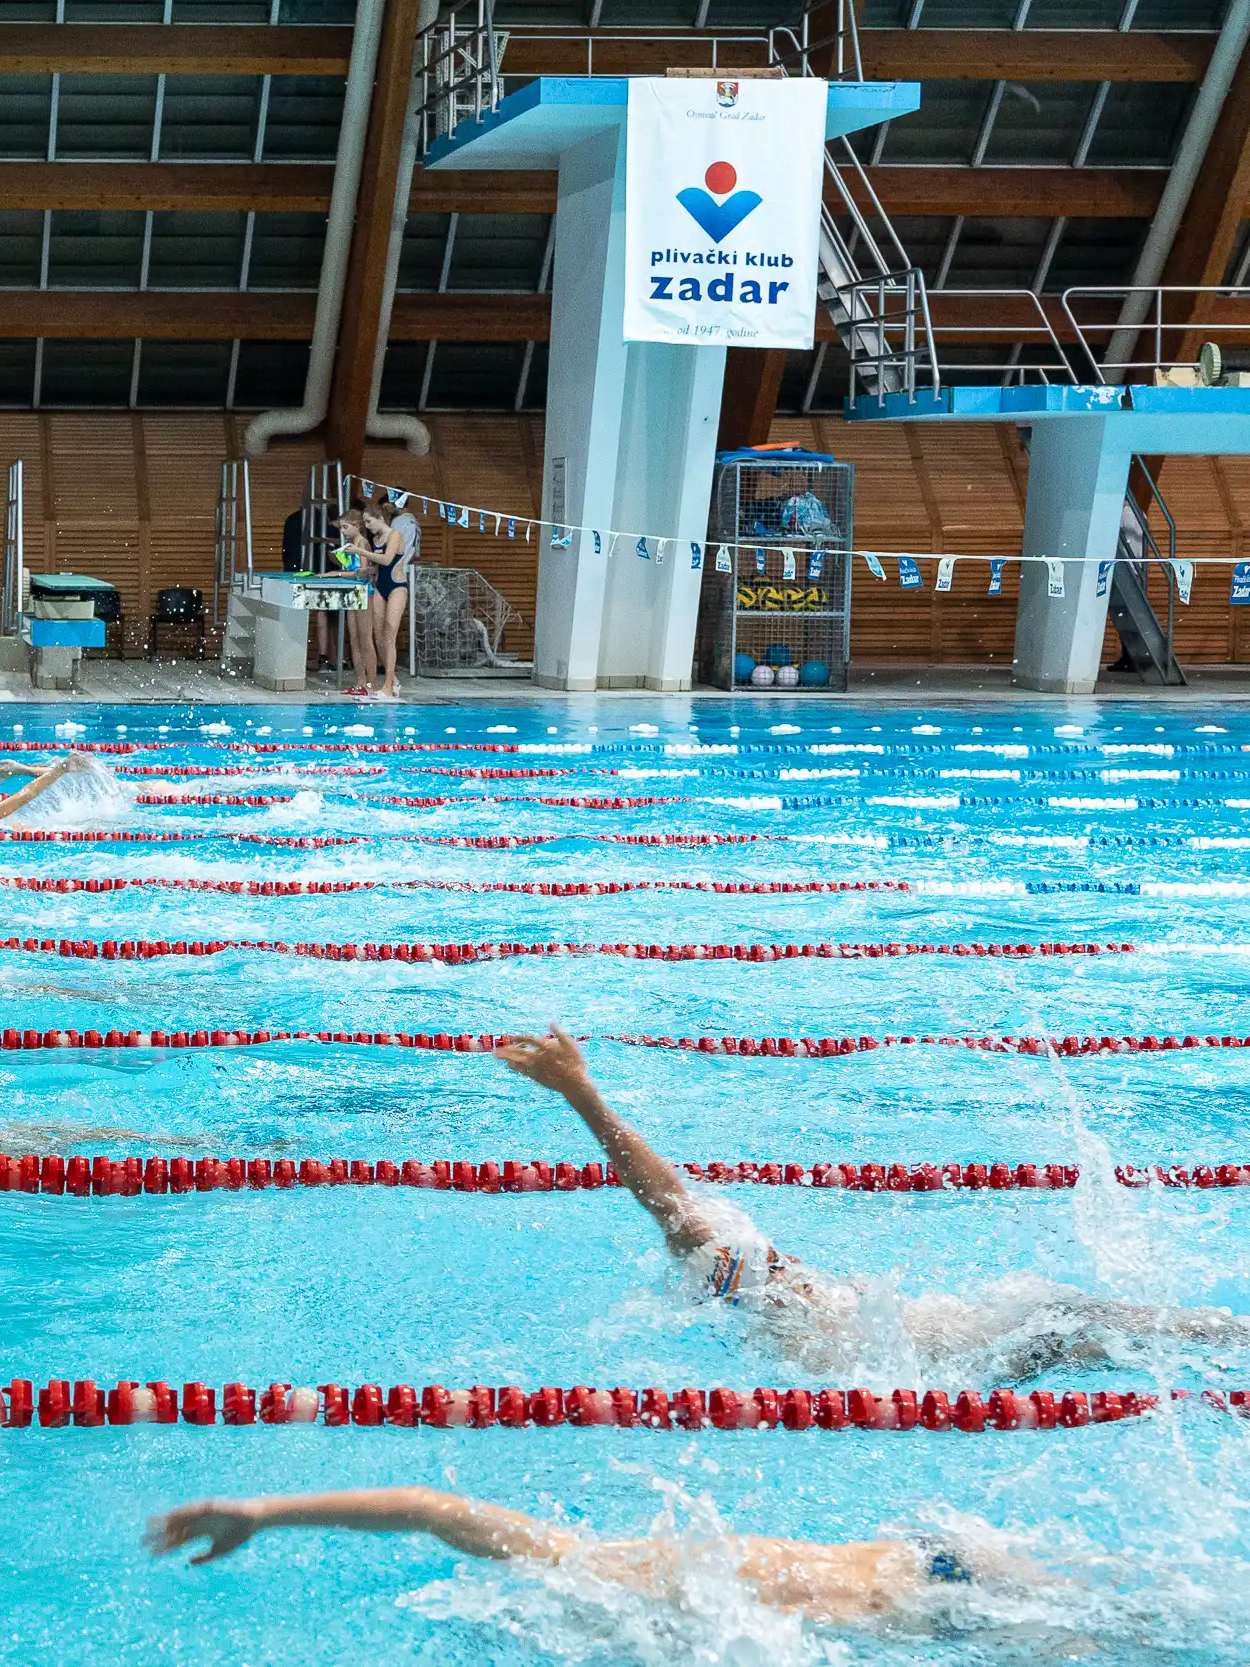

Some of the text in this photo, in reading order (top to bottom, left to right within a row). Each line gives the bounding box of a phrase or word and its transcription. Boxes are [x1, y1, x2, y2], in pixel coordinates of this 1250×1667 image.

[650, 248, 794, 268] plivački klub
[649, 272, 790, 305] zadar
[726, 327, 759, 338] godine
